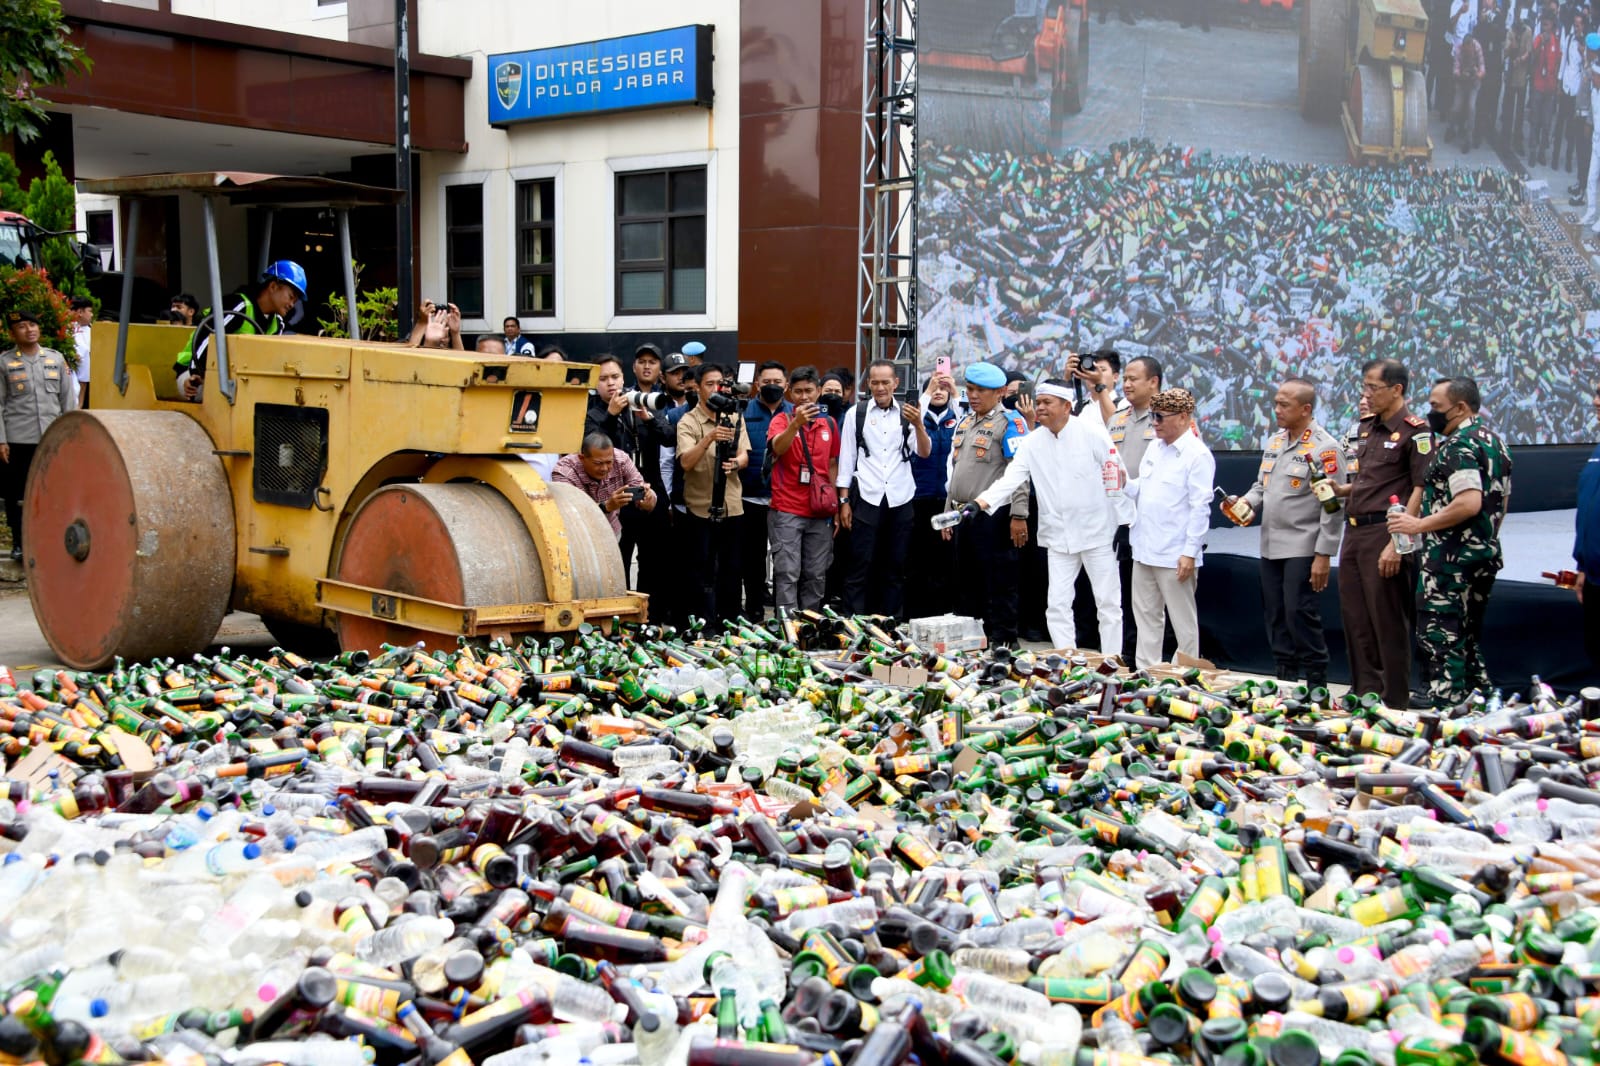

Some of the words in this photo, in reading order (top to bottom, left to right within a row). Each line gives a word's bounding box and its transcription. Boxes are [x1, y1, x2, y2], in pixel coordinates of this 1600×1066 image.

[536, 47, 684, 81] DITRESSIBER
[536, 80, 601, 99] POLDA
[613, 70, 684, 91] JABAR
